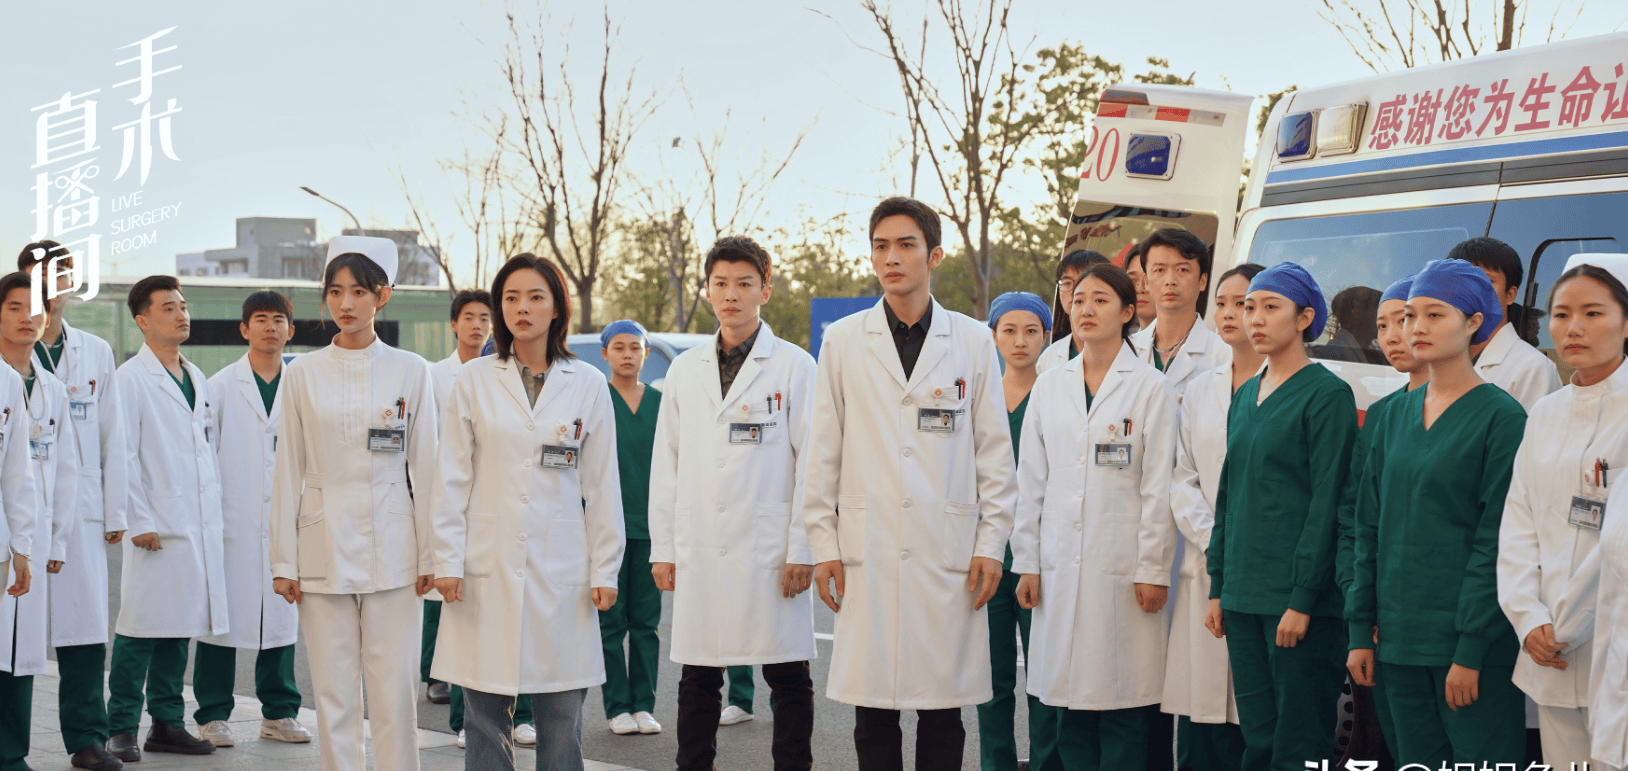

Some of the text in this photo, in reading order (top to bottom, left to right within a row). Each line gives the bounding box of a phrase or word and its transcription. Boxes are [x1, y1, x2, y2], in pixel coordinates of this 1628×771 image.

[1368, 62, 1628, 150] 感谢您为生命让
